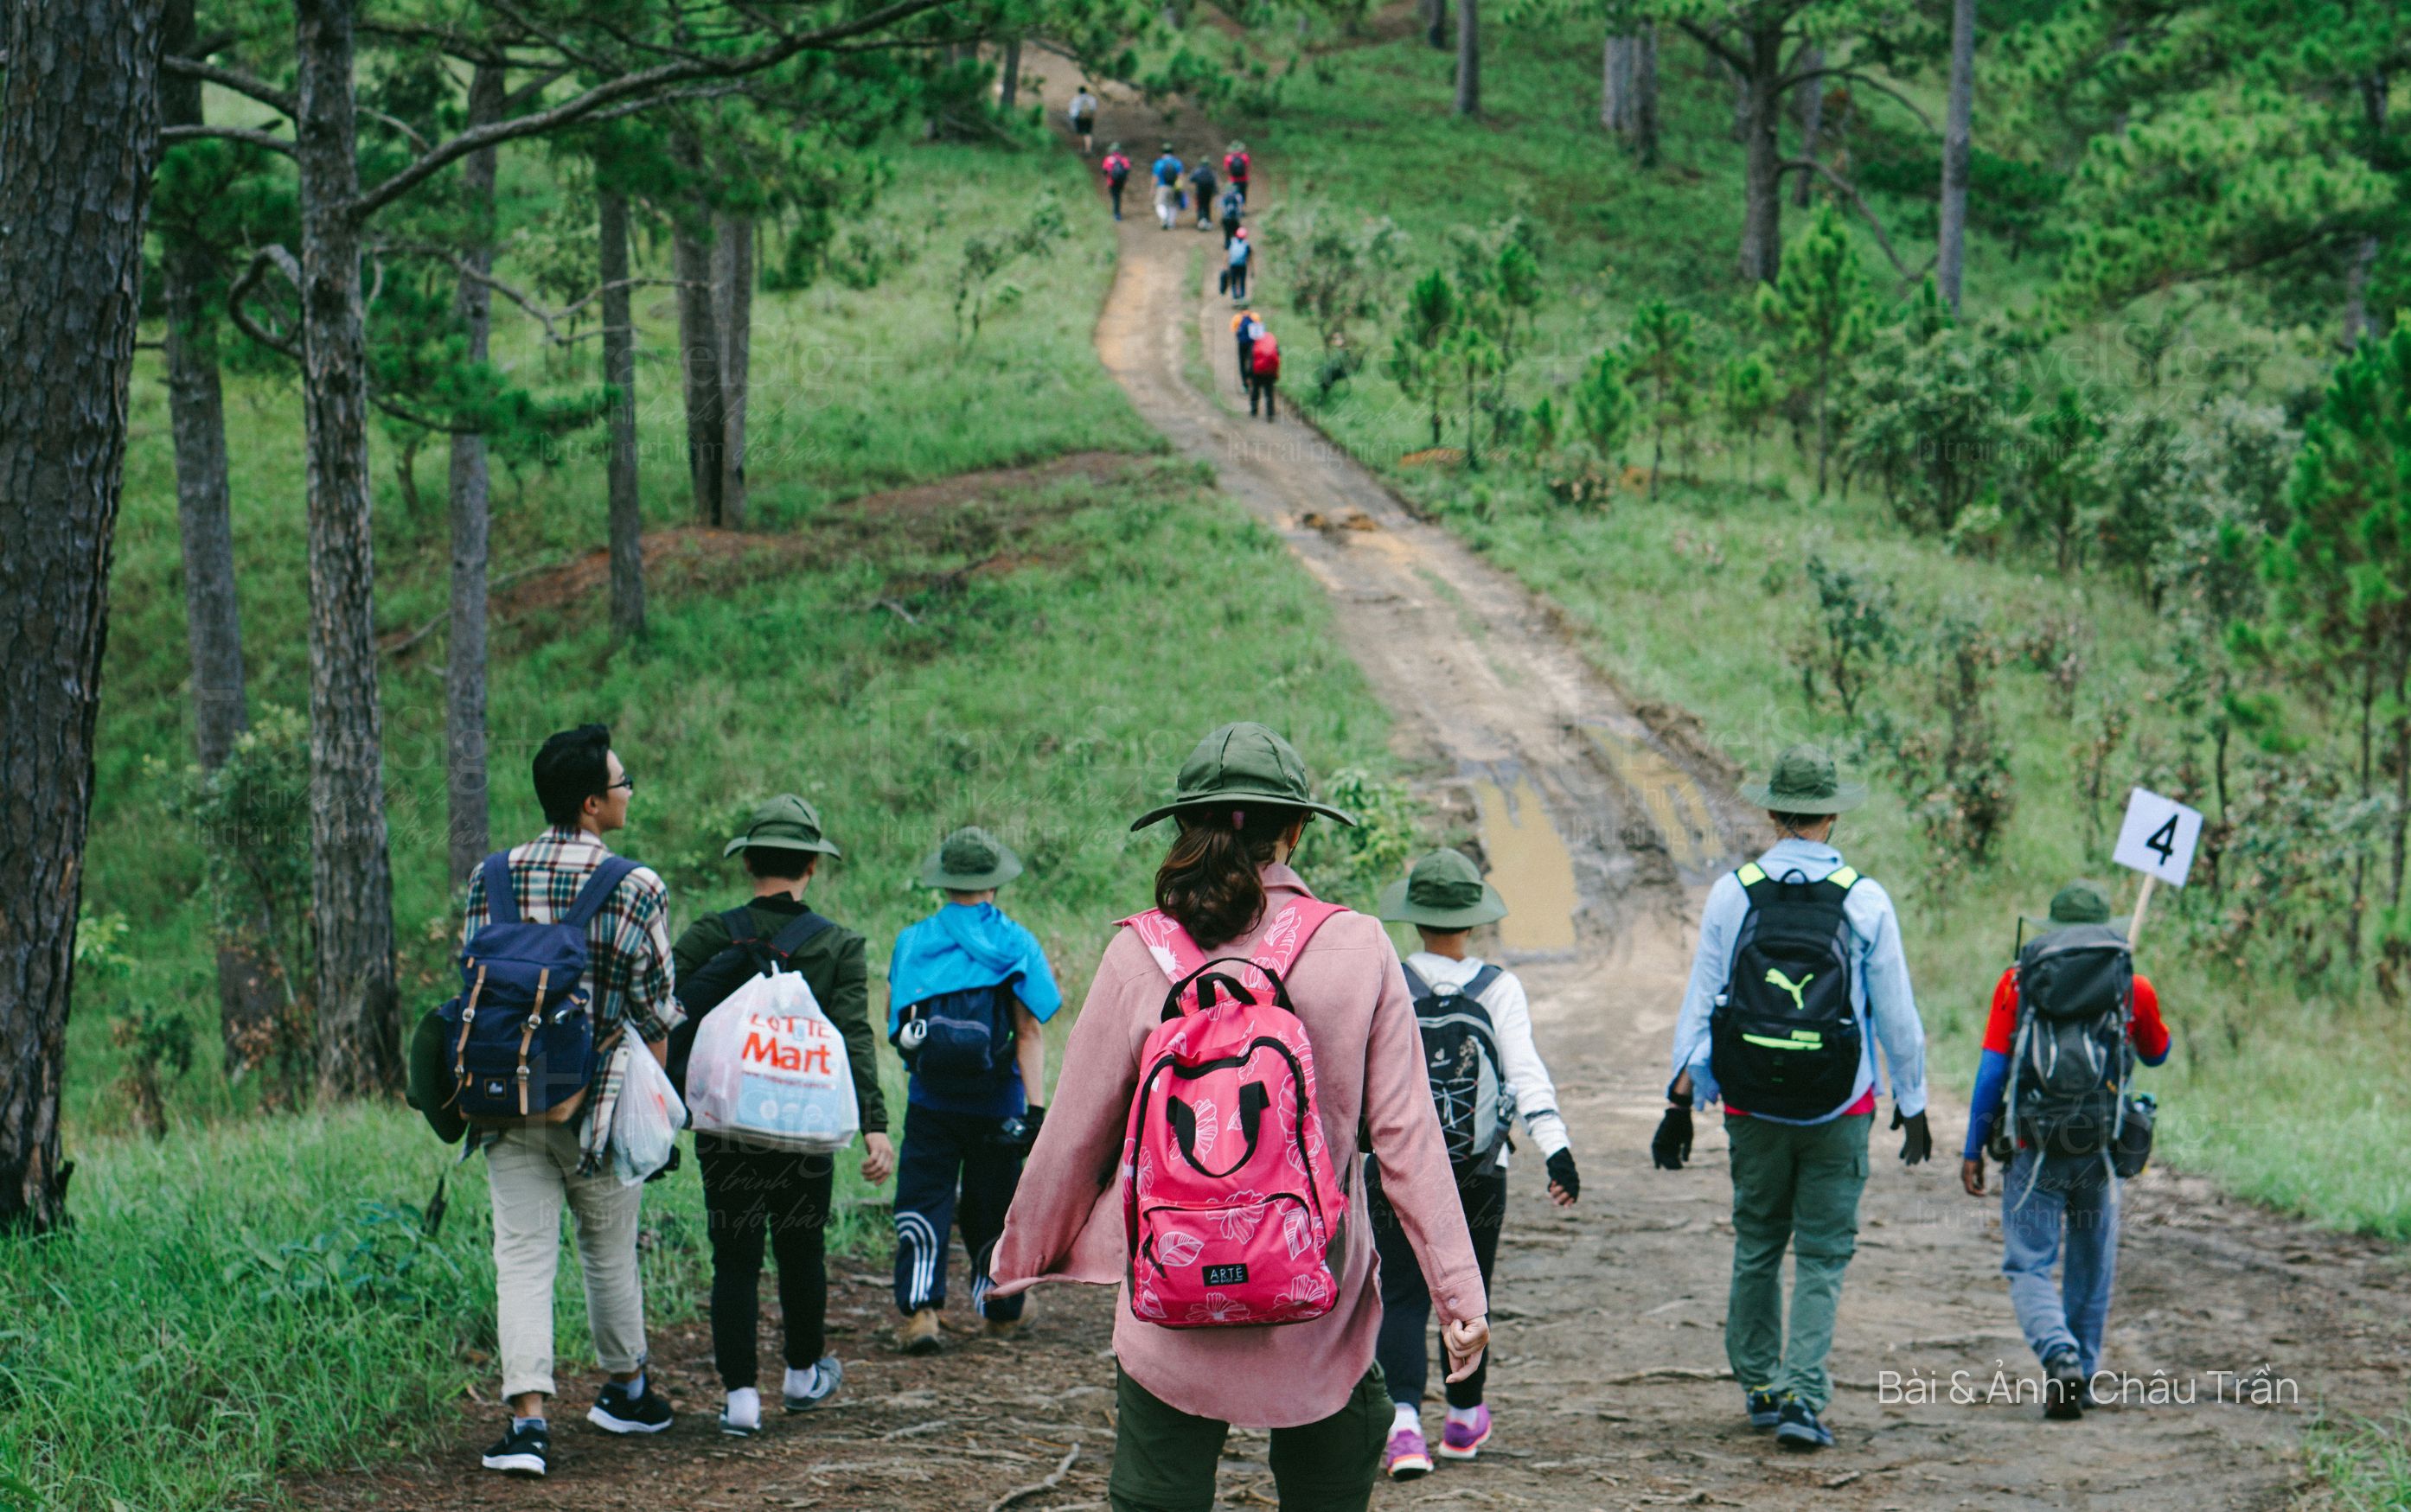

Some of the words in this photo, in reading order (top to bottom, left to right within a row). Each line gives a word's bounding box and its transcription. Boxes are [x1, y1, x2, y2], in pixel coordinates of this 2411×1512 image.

[2146, 813, 2179, 866] 4
[750, 1011, 831, 1039] LOTTE
[741, 1031, 831, 1076] Mart
